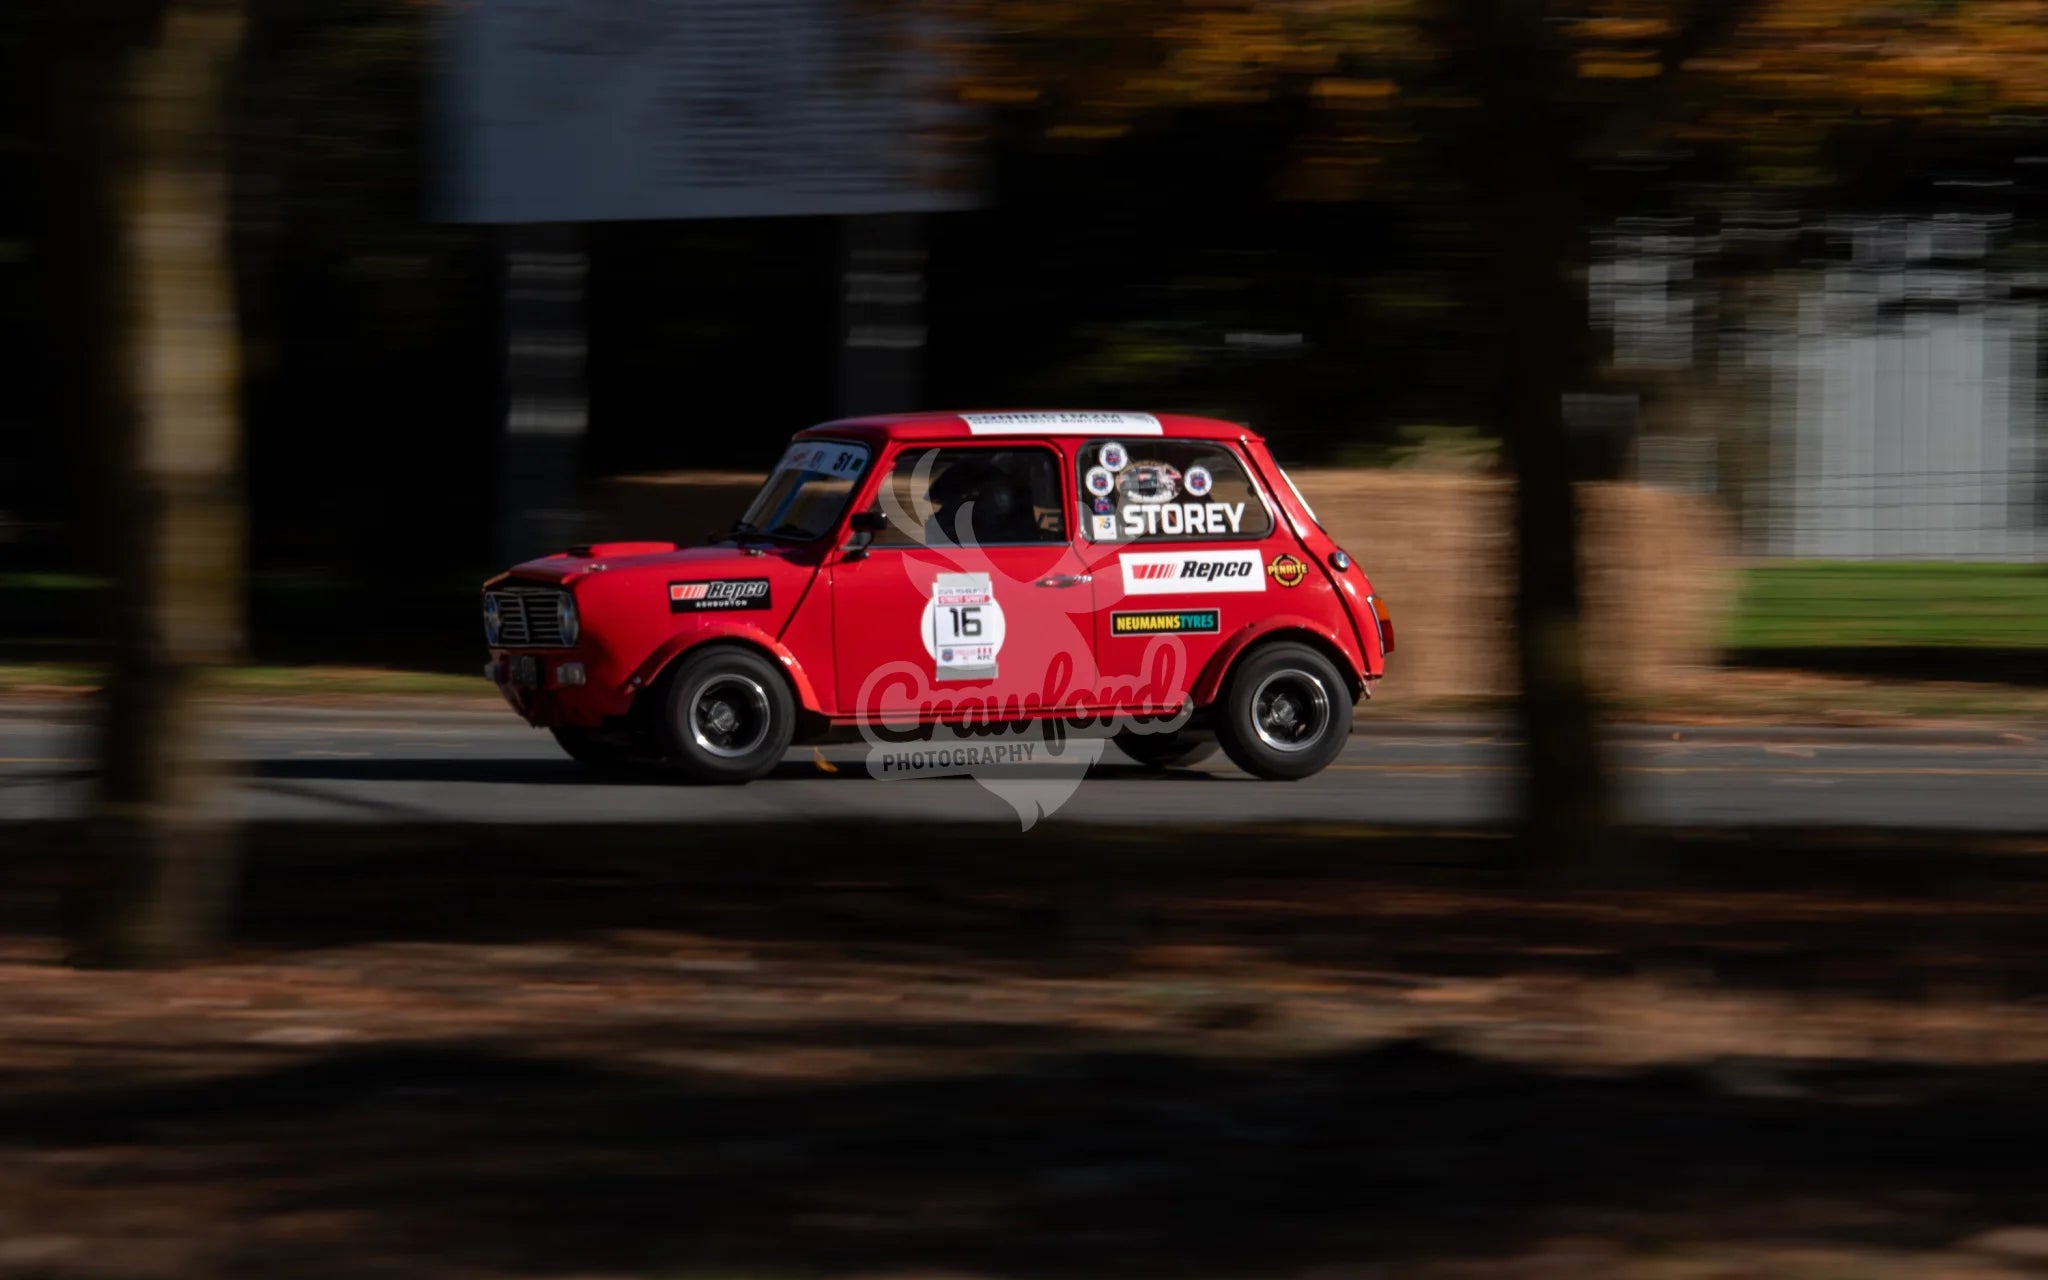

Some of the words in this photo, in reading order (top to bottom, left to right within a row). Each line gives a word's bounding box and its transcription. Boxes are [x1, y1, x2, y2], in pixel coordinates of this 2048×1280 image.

[1122, 503, 1245, 535] STOREY
[1180, 560, 1253, 582] Repco
[1267, 563, 1308, 576] PENRITE
[707, 581, 769, 601] Repco
[695, 600, 748, 608] ASHBURTON
[949, 607, 982, 637] 16
